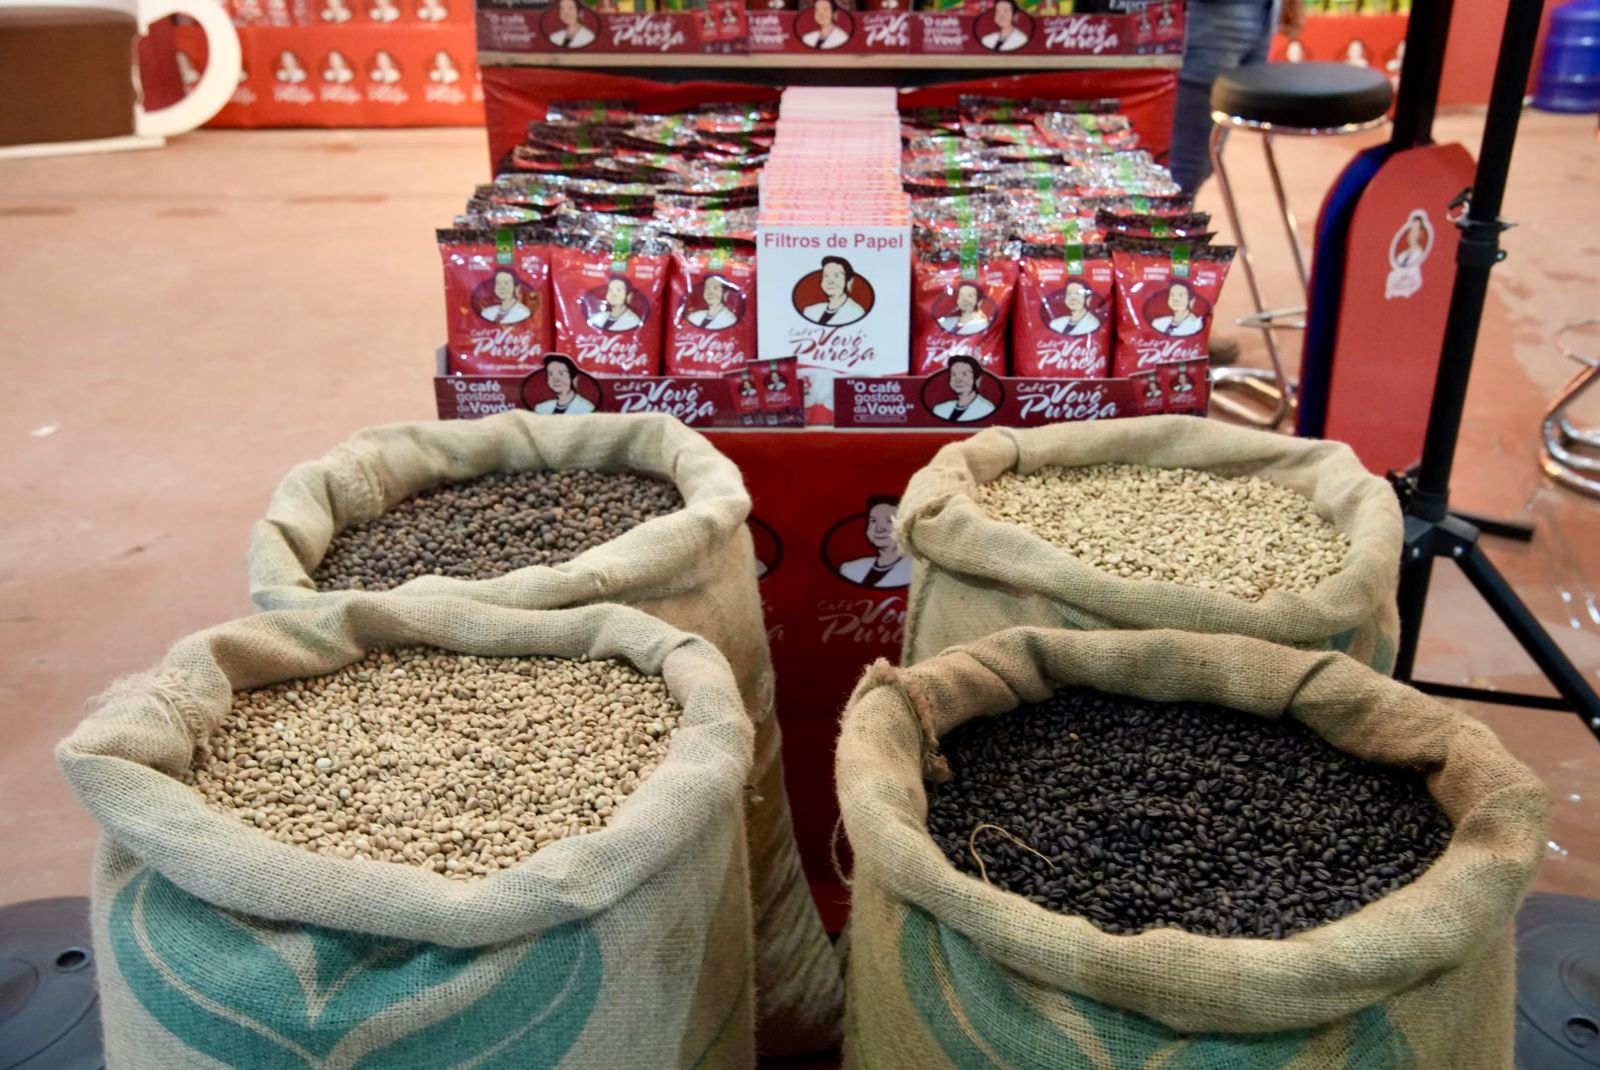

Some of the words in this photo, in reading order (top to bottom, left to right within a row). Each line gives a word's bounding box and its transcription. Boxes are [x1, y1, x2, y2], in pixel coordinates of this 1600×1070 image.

[764, 233, 820, 248] Filtros
[826, 233, 848, 248] de
[854, 233, 904, 252] Papel
[816, 326, 865, 347] Vovó
[471, 337, 542, 362] Pureza
[789, 338, 876, 368] Pureza
[469, 380, 501, 392] café
[641, 379, 699, 402] Vovó
[868, 381, 902, 393] café
[1016, 383, 1045, 393] Café
[1045, 381, 1104, 404] Vovó
[854, 394, 905, 405] gostoso
[1017, 394, 1117, 420] Pureza
